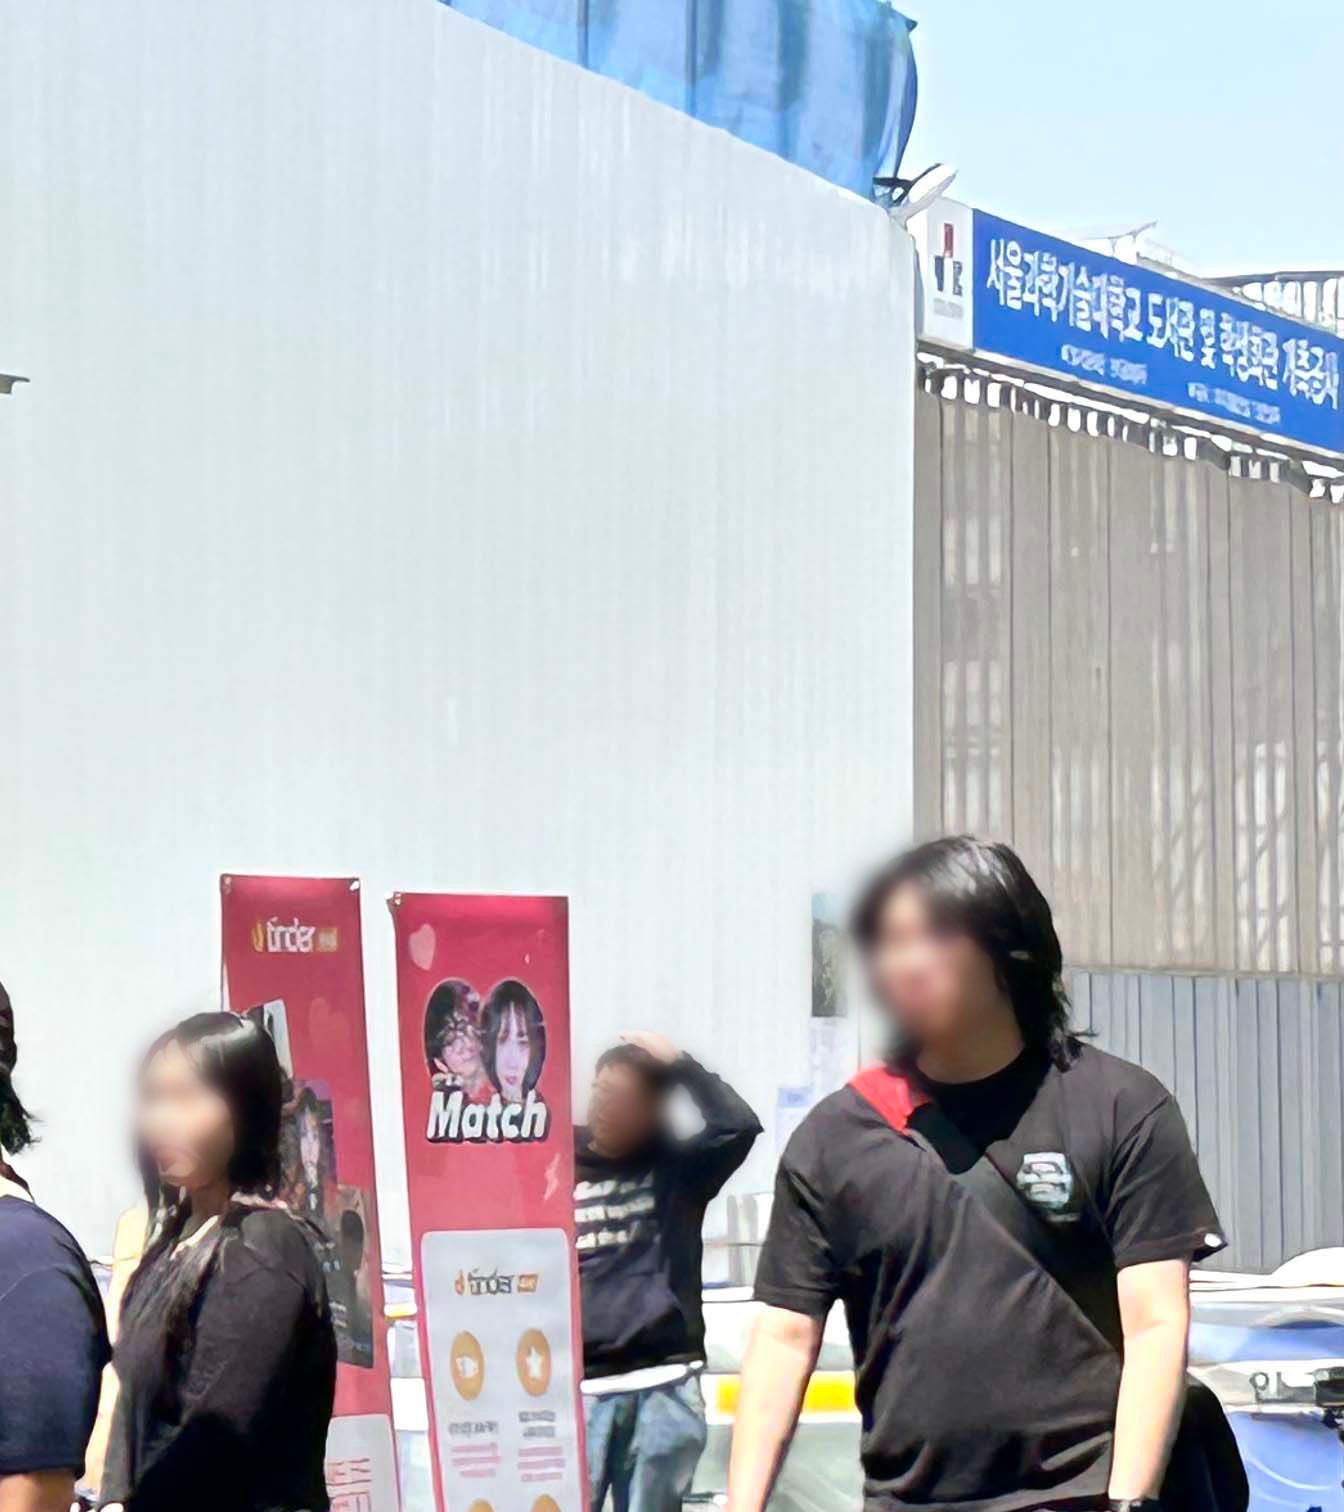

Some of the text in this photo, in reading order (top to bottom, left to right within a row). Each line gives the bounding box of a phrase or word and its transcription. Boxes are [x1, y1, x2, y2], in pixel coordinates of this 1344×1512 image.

[987, 238, 1144, 342] 서울과학기술대학교
[1199, 308, 1216, 369] 및
[425, 1089, 551, 1145] Match
